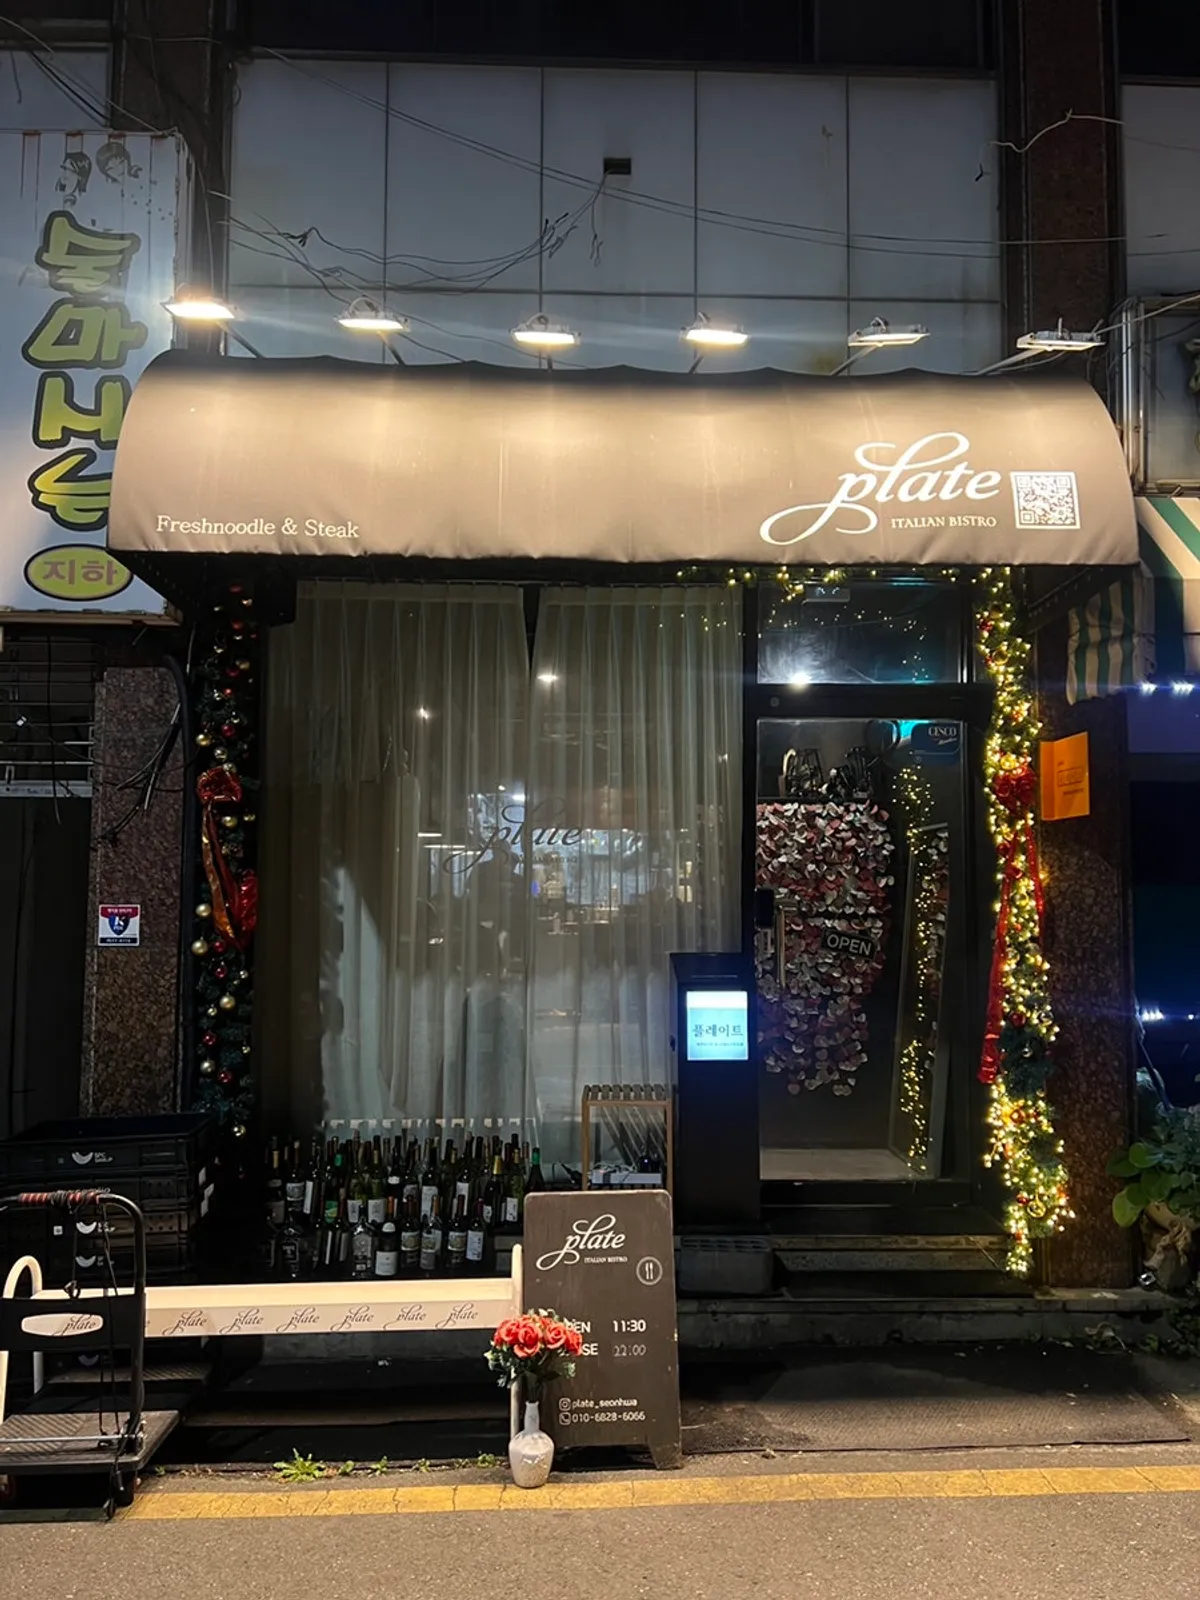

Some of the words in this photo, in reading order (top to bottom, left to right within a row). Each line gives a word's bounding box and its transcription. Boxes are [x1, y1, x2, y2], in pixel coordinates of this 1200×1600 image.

[759, 432, 1002, 545] plate
[155, 514, 276, 536] Freshnoodle
[281, 517, 298, 536] &
[304, 518, 360, 539] Steak
[890, 516, 946, 530] ITALIAN
[949, 515, 998, 529] BISTRO
[42, 559, 119, 587] 지하
[826, 933, 872, 956] OPEN
[691, 1023, 744, 1038] 플레이트
[535, 1213, 627, 1271] plate
[52, 1314, 96, 1336] plate
[162, 1308, 207, 1335] plate
[218, 1307, 264, 1334] plate
[276, 1306, 320, 1333] plate
[330, 1304, 374, 1332] plate
[383, 1304, 427, 1331] plate
[435, 1303, 479, 1330] plate
[612, 1319, 647, 1333] 11:30
[613, 1344, 647, 1357] 22:00
[571, 1397, 638, 1410] plate_seonhwa
